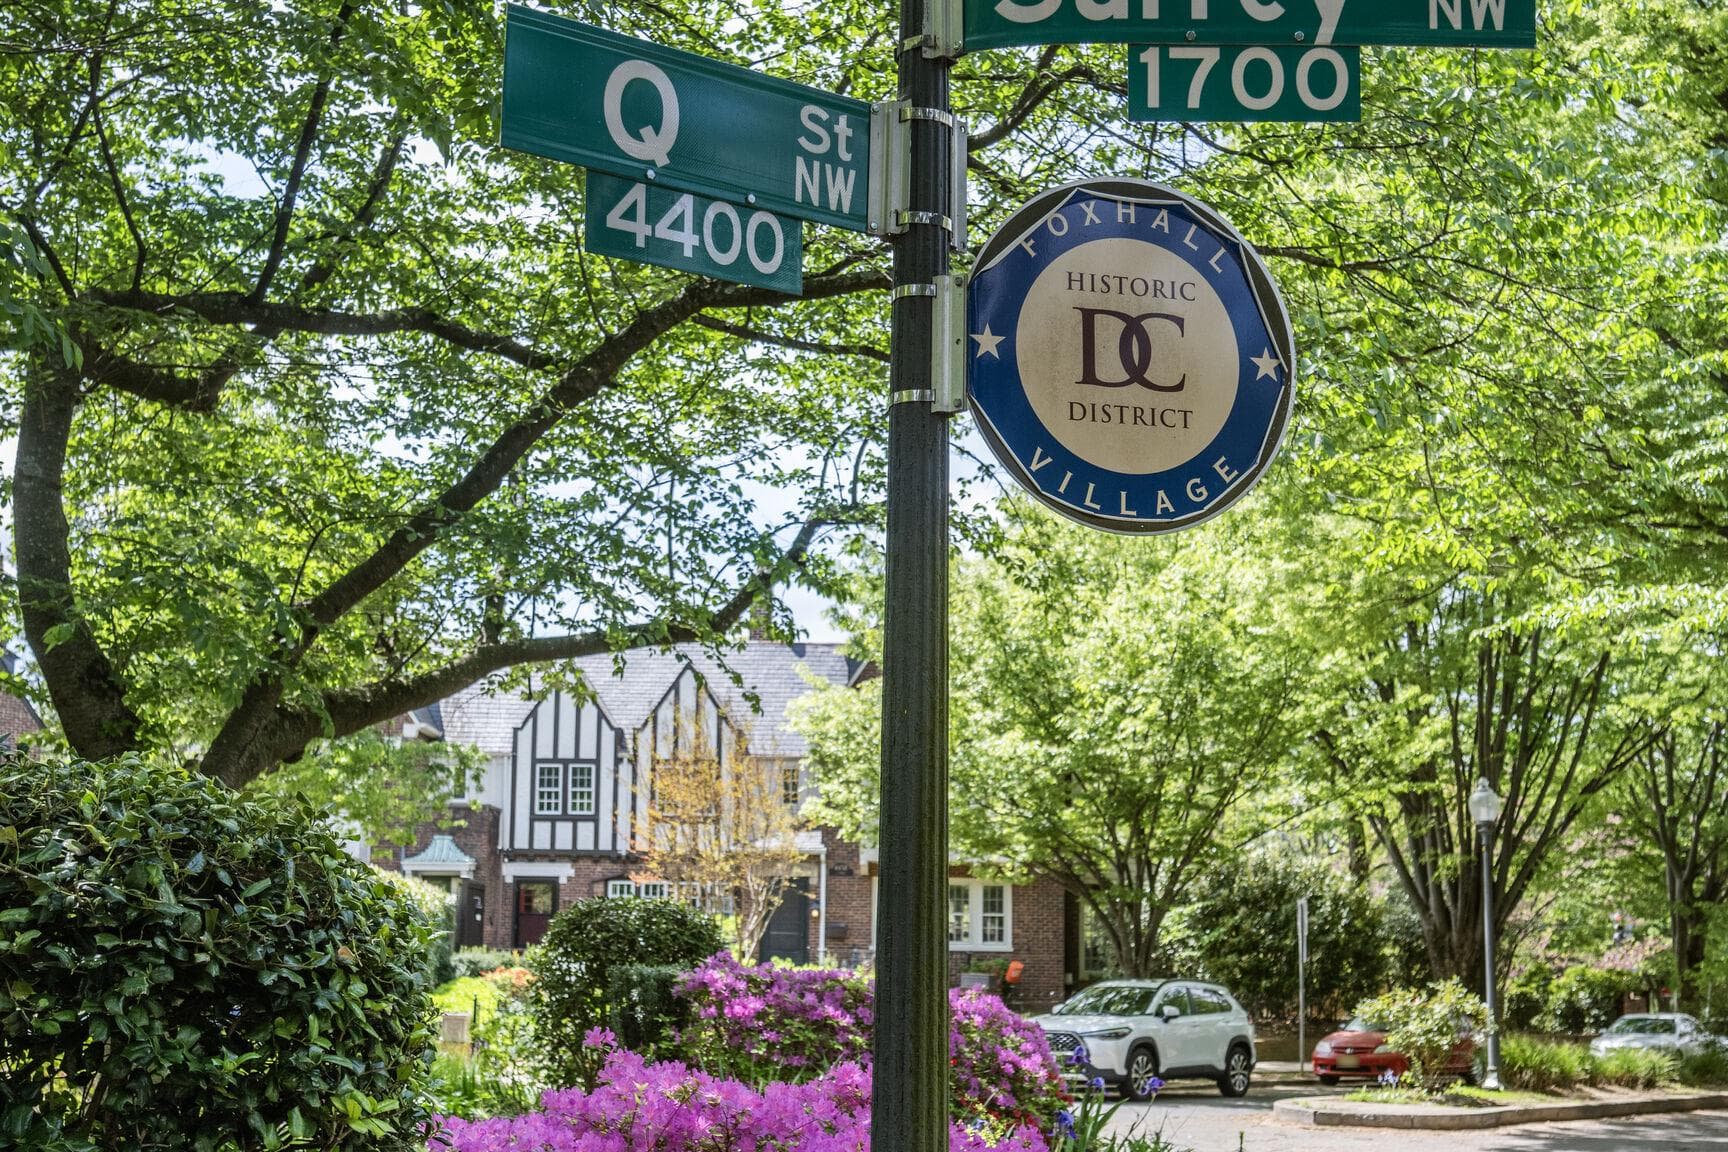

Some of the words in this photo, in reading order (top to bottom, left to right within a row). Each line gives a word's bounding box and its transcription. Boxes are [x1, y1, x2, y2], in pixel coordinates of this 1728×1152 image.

[1428, 0, 1506, 31] NW
[1140, 47, 1350, 111] 1700
[603, 60, 680, 167] Q
[799, 105, 853, 162] St
[794, 156, 856, 214] NW
[607, 183, 784, 275] 4400
[1021, 201, 1231, 273] FOXHALL
[1067, 272, 1196, 301] HISTORIC
[1072, 306, 1186, 393] DC
[1069, 402, 1193, 428] DISTRICT
[1031, 448, 1238, 516] VILLAGE
